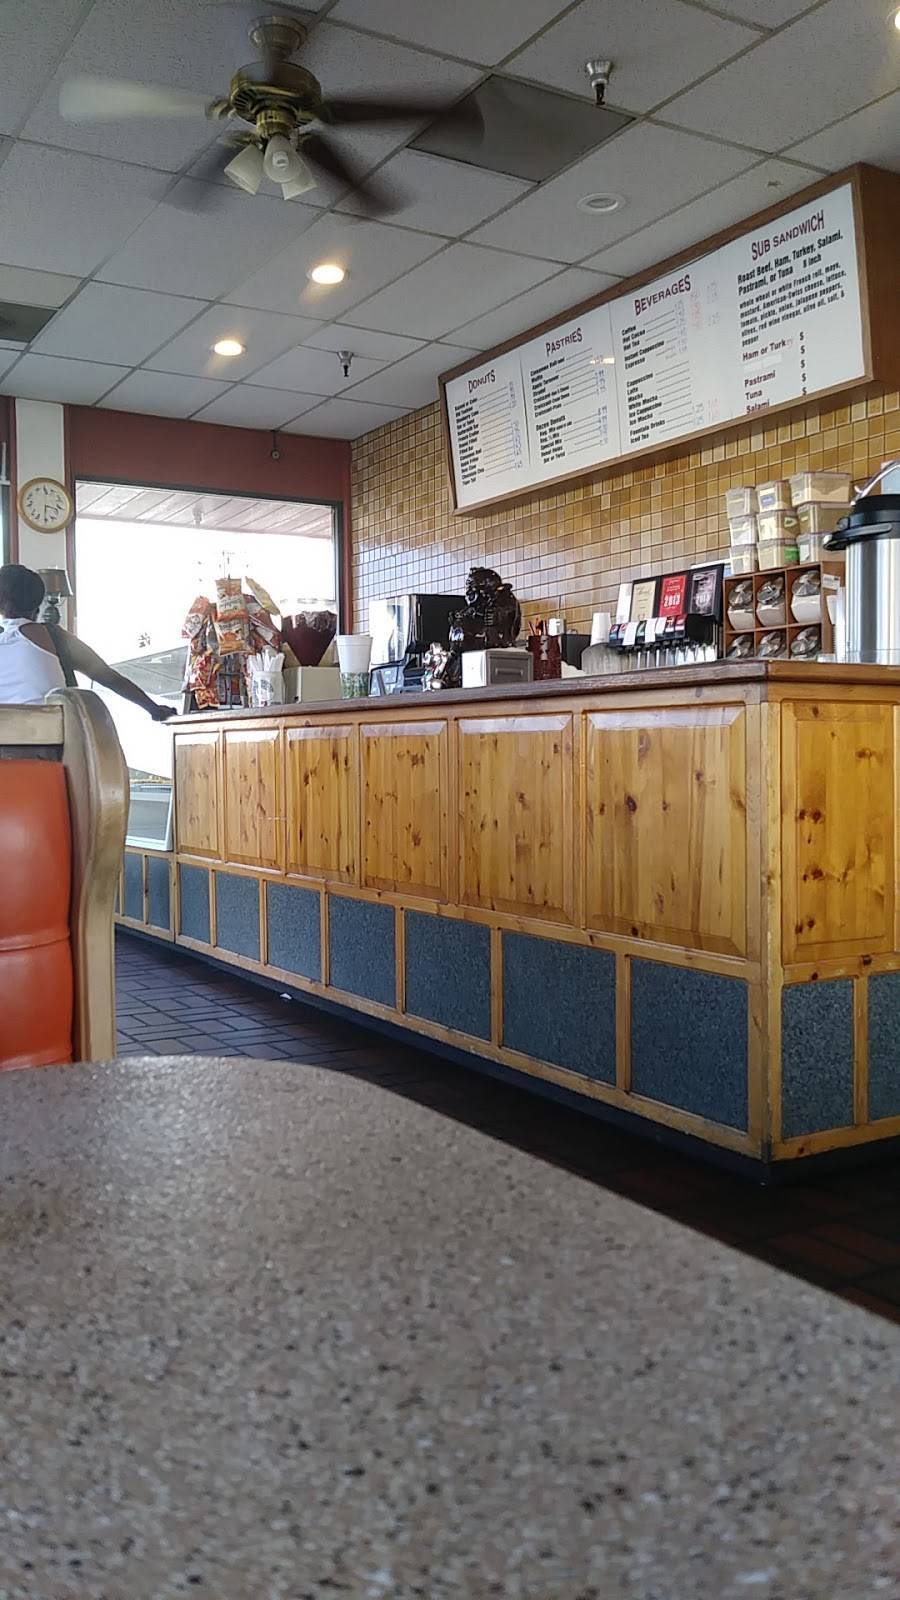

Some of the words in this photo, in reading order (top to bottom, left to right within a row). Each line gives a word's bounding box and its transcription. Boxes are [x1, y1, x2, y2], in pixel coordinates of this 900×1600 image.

[752, 239, 770, 260] SUB
[773, 210, 824, 247] SANDWICH
[738, 270, 755, 284] Roast
[770, 274, 776, 282] or
[778, 266, 793, 278] Tuna
[808, 254, 821, 265] inch
[634, 274, 691, 316] BEVERAGES
[546, 328, 582, 357] PASTRIES
[743, 351, 758, 361] Ham
[761, 346, 768, 355] or
[468, 369, 495, 393] DONUTS
[745, 370, 775, 388] Pastrami
[745, 390, 762, 400] Tuna
